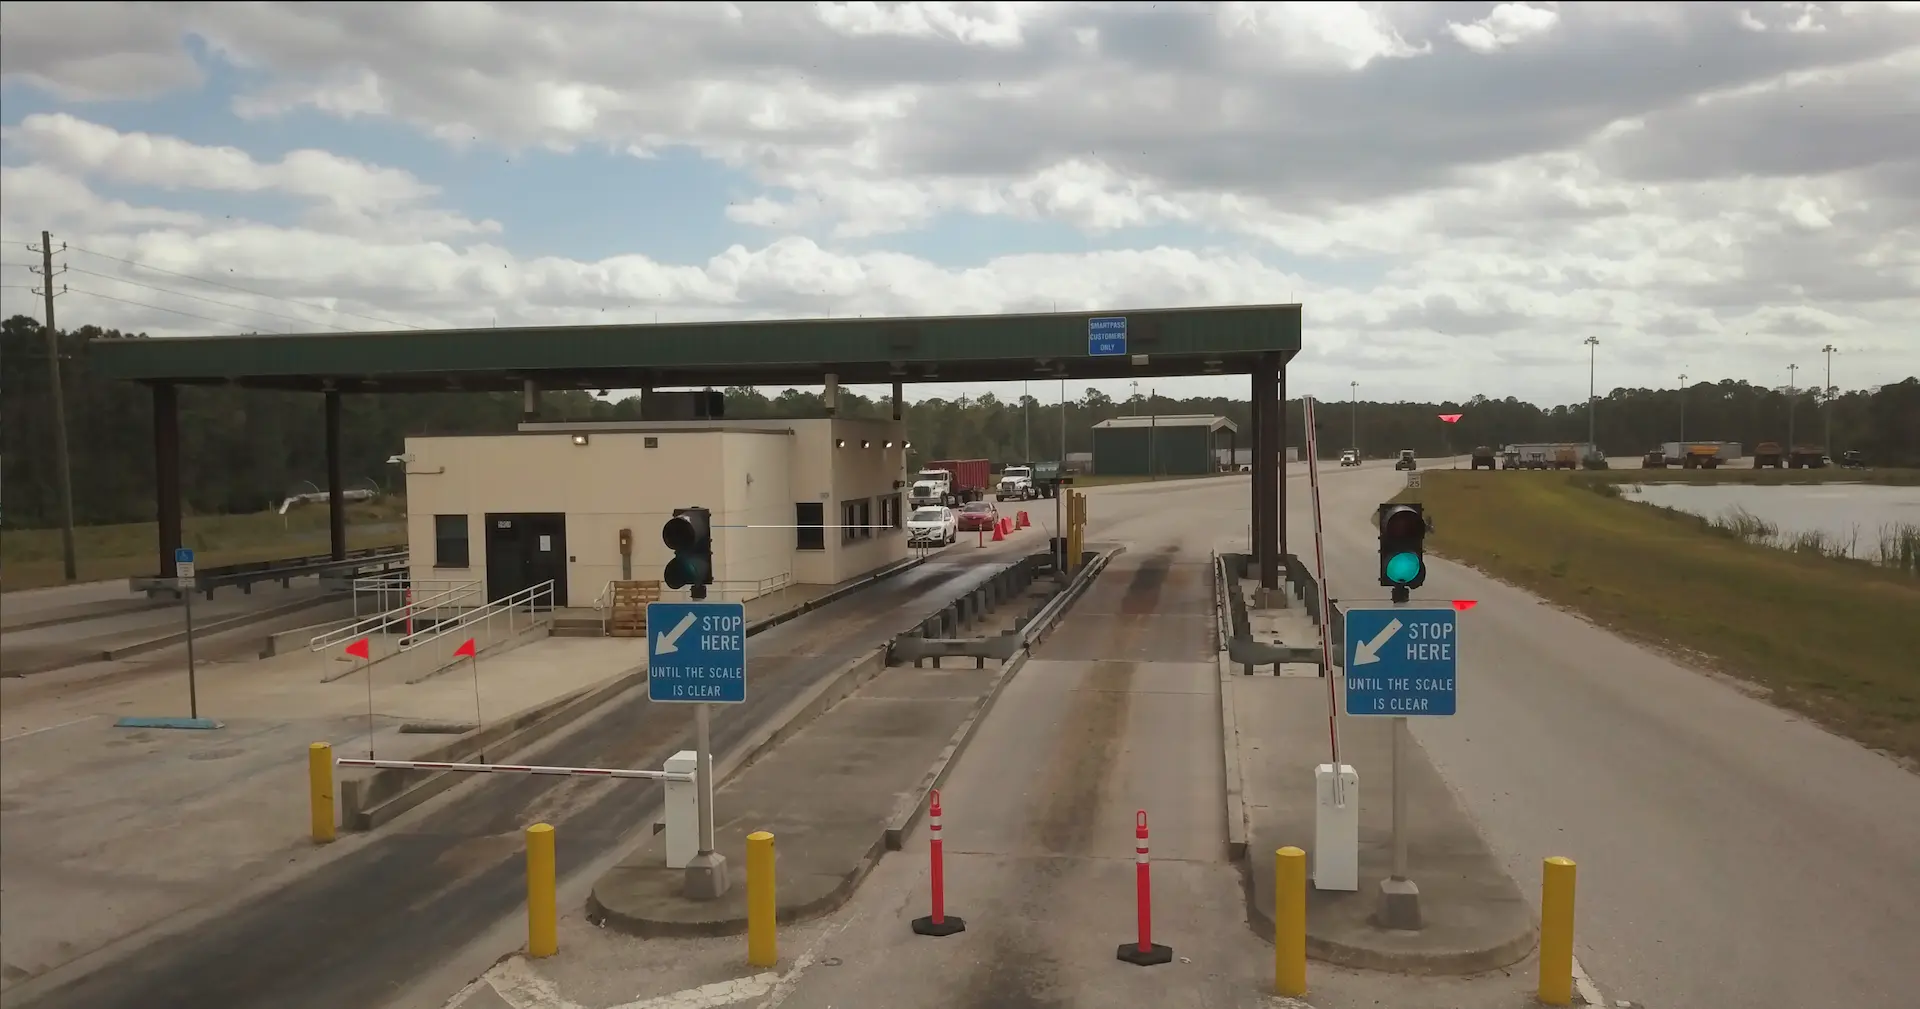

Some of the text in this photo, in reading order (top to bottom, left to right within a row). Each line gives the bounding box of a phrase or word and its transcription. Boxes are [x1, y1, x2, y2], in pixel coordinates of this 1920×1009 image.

[1090, 321, 1125, 329] SMARTPASS
[1090, 332, 1125, 340] CUSTOMERS
[1409, 480, 1420, 488] 25
[702, 615, 741, 632] STOP
[1408, 622, 1453, 640] STOP
[701, 634, 740, 651] HERE
[1406, 643, 1451, 661] HERE
[651, 666, 742, 679] UNTIL THE SCALE
[672, 684, 721, 697] IS CLEAR
[1348, 678, 1453, 691] UNTIL THE SCALE
[1373, 698, 1429, 710] IS CLEAR
